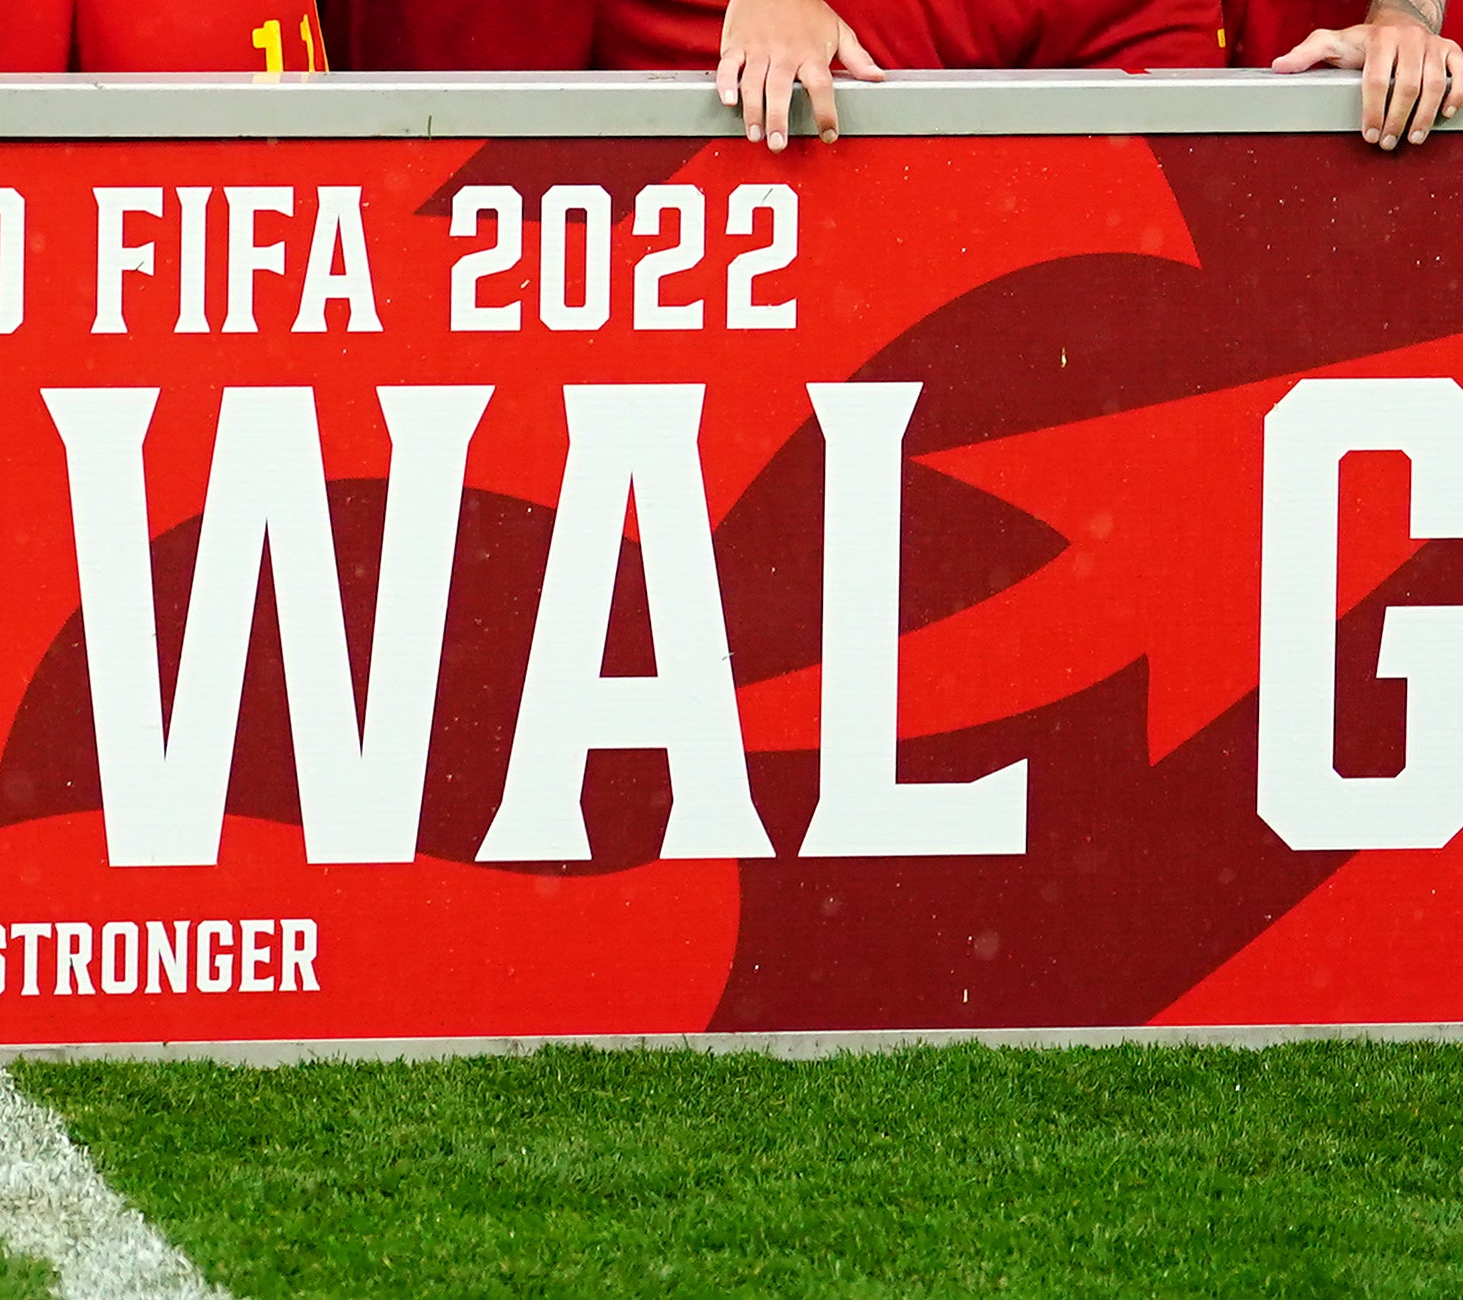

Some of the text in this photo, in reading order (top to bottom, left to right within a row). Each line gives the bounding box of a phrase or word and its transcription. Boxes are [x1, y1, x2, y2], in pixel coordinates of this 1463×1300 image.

[90, 186, 384, 334] FIFA
[449, 184, 799, 332] 2022
[40, 381, 1029, 868] WAL
